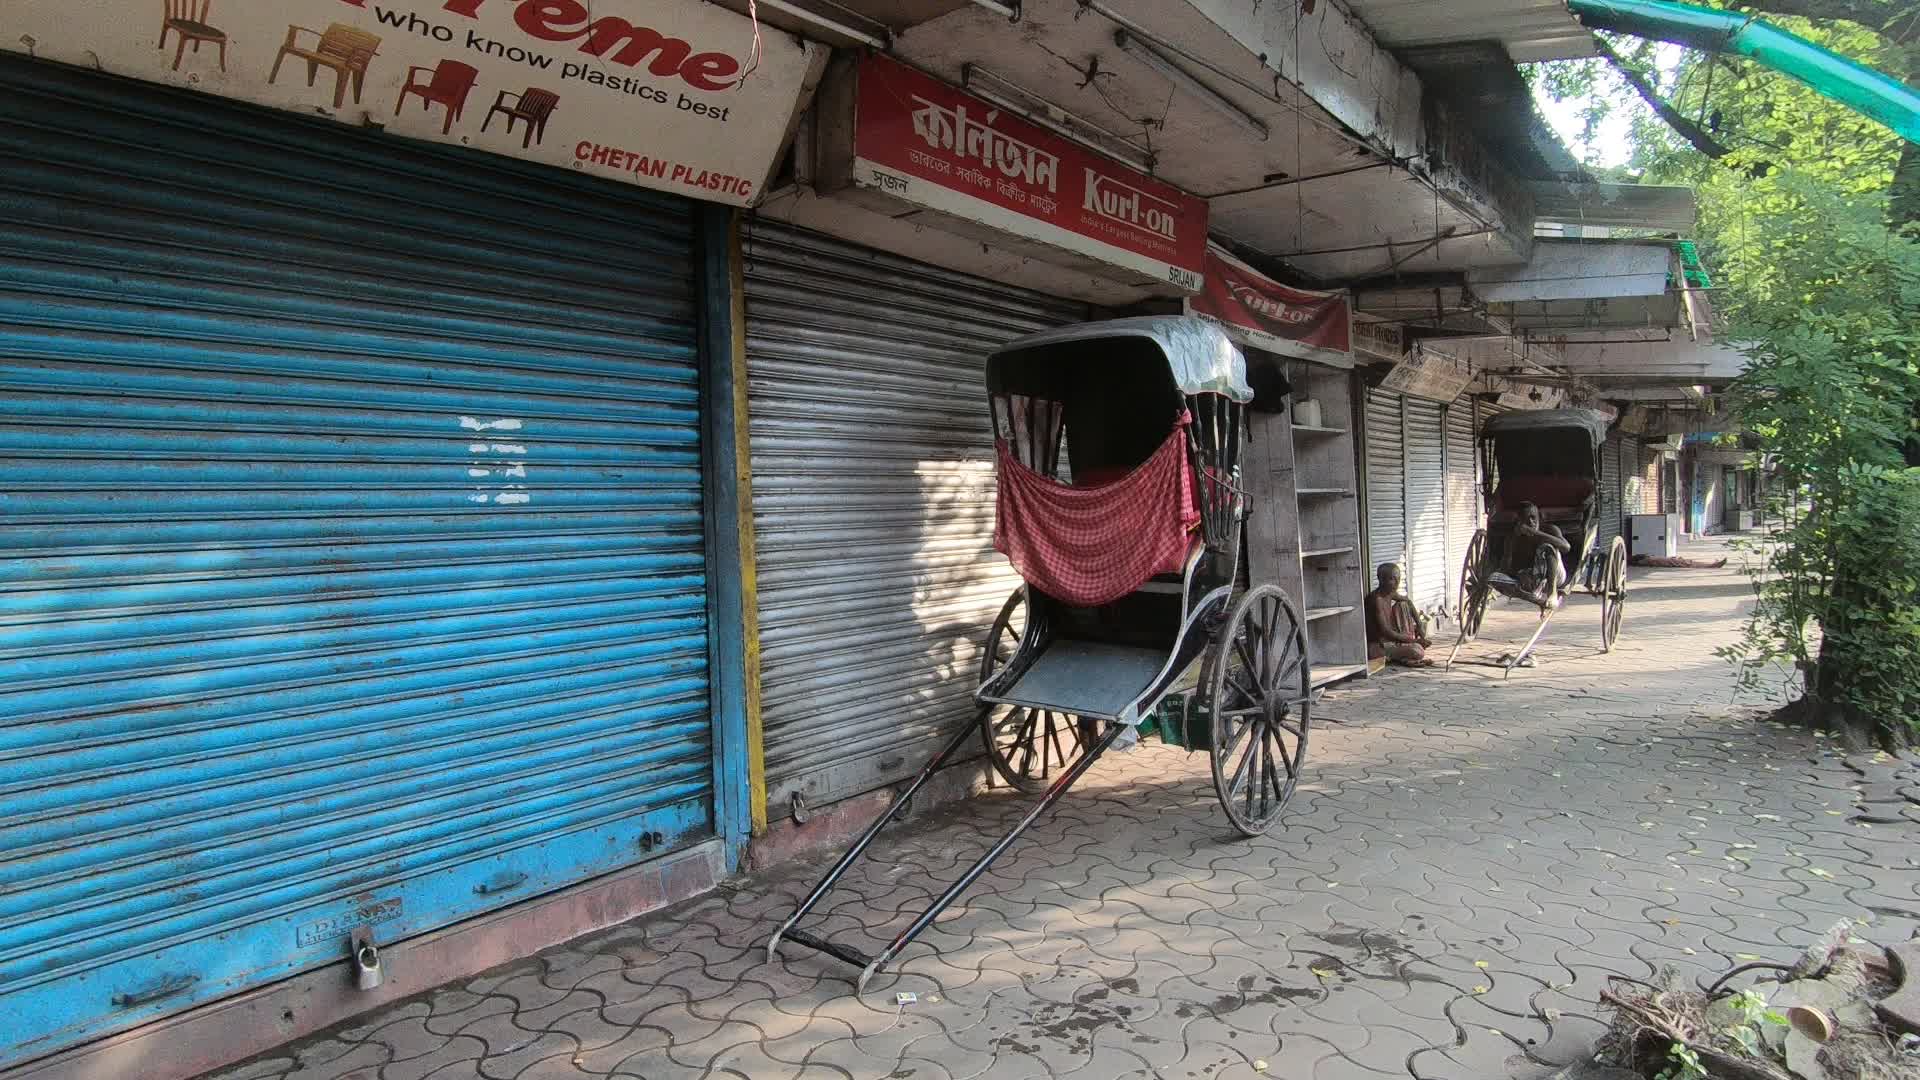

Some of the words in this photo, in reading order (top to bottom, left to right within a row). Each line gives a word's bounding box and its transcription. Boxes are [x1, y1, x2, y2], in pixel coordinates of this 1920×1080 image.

[374, 6, 453, 41] who
[466, 29, 553, 69] know
[560, 62, 669, 104] plastics
[676, 93, 730, 122] best
[575, 140, 667, 179] CHETAN
[671, 164, 752, 196] PLASTIC
[909, 150, 951, 176] ভারতের
[1082, 167, 1177, 240] Kurl-on
[1168, 266, 1196, 289] SRIJAN
